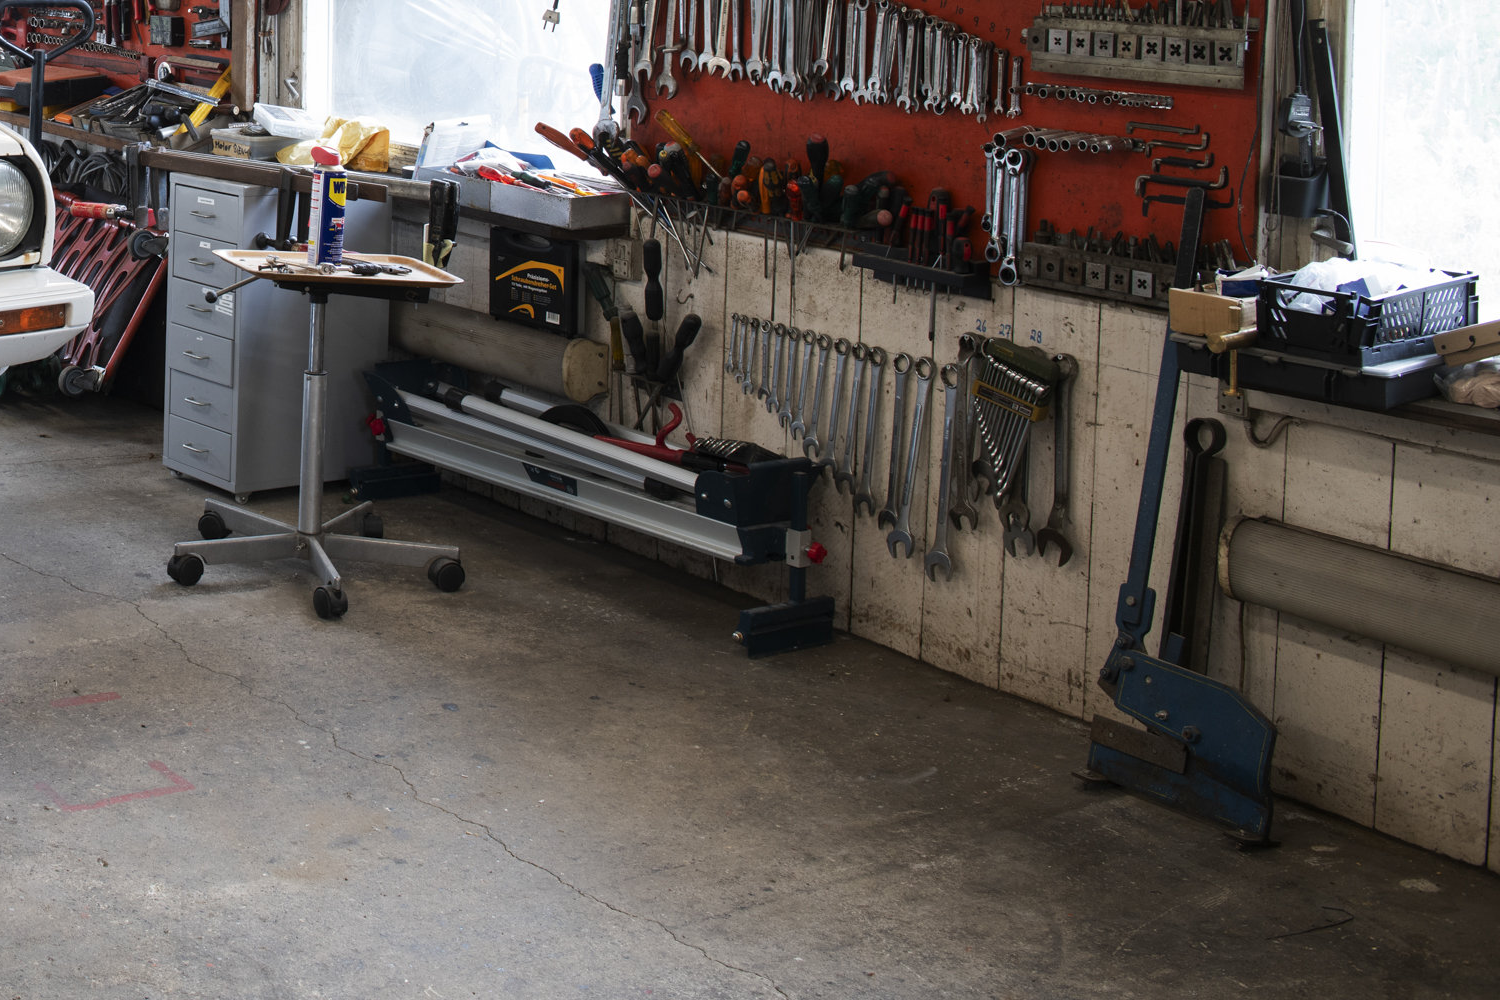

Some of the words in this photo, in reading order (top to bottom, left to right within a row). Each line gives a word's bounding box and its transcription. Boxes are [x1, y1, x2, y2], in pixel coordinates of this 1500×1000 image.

[975, 318, 987, 333] 26
[998, 323, 1012, 338] 27
[1029, 329, 1043, 344] 28
